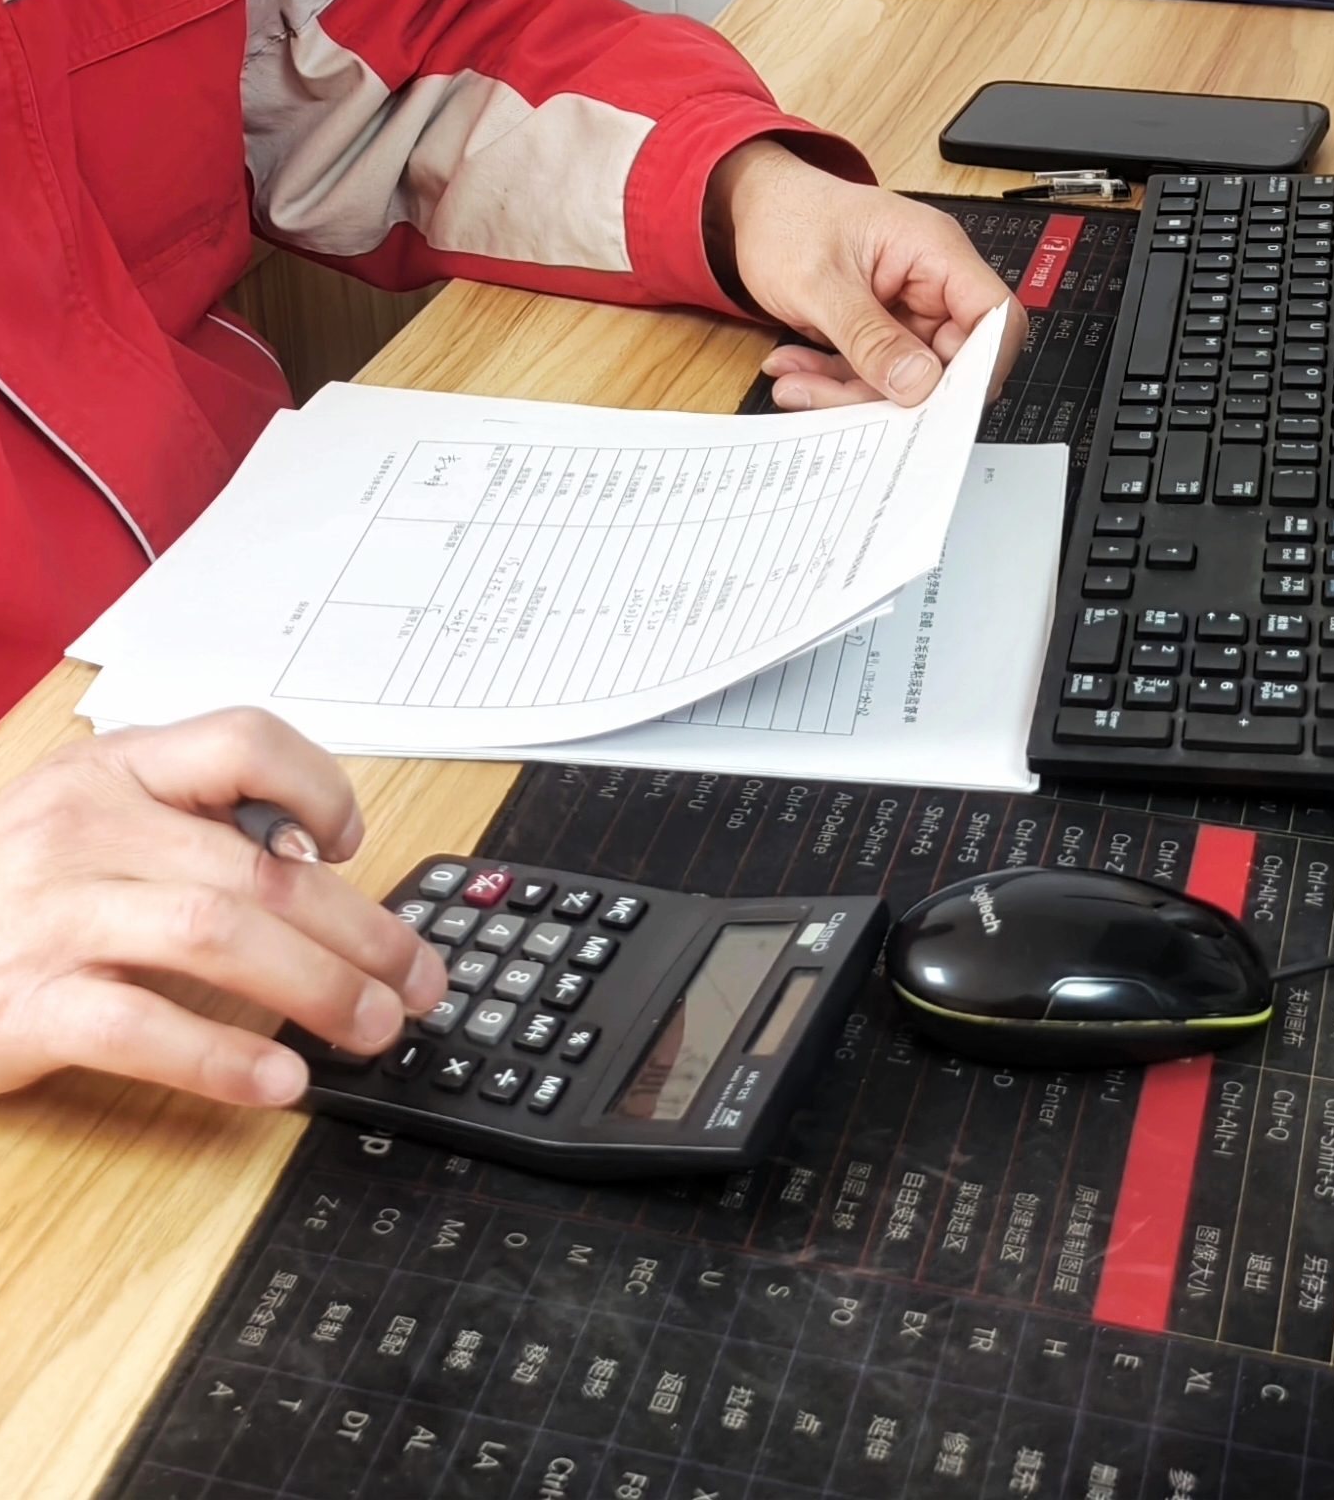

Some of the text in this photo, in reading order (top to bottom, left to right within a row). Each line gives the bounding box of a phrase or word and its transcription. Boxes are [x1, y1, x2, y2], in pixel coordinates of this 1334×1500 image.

[1029, 253, 1057, 288] PPT快捷键
[1054, 319, 1075, 340] Alt+EL
[1083, 321, 1104, 347] Alt+EM
[1228, 613, 1240, 621] 4
[1289, 615, 1303, 623] 7
[1161, 645, 1175, 653] 2
[1224, 647, 1237, 655] 5
[1156, 679, 1170, 687] 3
[1220, 681, 1234, 690] 6
[1284, 684, 1298, 693] 9
[726, 779, 764, 829] Ctrl+Tab
[778, 785, 809, 823] Ctrl+R
[1306, 808, 1324, 816] L
[816, 791, 855, 855] Alt+Delete
[857, 799, 900, 867] Ctrl+Shift+I
[909, 805, 946, 856] Shift+F6
[957, 812, 990, 864] Shift+F5
[1153, 840, 1180, 879] Ctrl+X
[430, 870, 454, 882] 0
[467, 872, 504, 893] C/AC
[1253, 855, 1283, 921] Ctrl+Alt+C
[1304, 861, 1329, 907] Ctrl+W
[443, 918, 466, 926] 1
[605, 896, 638, 920] MC
[969, 883, 1002, 936] logitech
[487, 923, 511, 936] 4
[535, 933, 560, 947] 7
[810, 912, 846, 953] CASIO
[576, 935, 609, 963] MR
[459, 960, 484, 975] 5
[505, 970, 531, 984] 8
[477, 1010, 503, 1025] 9
[524, 1014, 557, 1041] M+
[1282, 987, 1311, 1048] 关闭画布
[568, 1031, 590, 1047] %
[834, 1013, 868, 1060] Ctrl+G
[534, 1075, 566, 1103] MU
[1265, 1089, 1295, 1142] Ctrl+Q
[831, 1160, 873, 1230] 图层上移
[884, 1171, 927, 1242] 自由变换
[303, 1195, 340, 1232] Z+E
[371, 1207, 401, 1235] CO
[941, 1181, 984, 1253] 取消选区
[999, 1192, 1041, 1264] 创建选区
[430, 1219, 466, 1251] MA
[1052, 1184, 1100, 1294] 原位复制图层
[566, 1243, 593, 1265] M
[1186, 1224, 1222, 1298] 图像大小
[622, 1256, 660, 1296] REC
[697, 1270, 725, 1287] U
[1242, 1251, 1276, 1292] 退出
[1298, 1253, 1329, 1314] 另存为
[766, 1283, 791, 1298] S
[236, 1270, 299, 1347] 显示全图
[309, 1300, 353, 1343] 复制
[829, 1296, 858, 1327] PO
[376, 1314, 419, 1357] 匹配
[898, 1310, 928, 1340] EX
[967, 1327, 999, 1351] TR
[441, 1329, 484, 1373] 偏移
[1042, 1338, 1068, 1358] H
[1112, 1352, 1144, 1371] E
[510, 1342, 550, 1385] 移动
[580, 1355, 620, 1400] 矩形
[207, 1380, 236, 1398] A
[647, 1370, 688, 1415] 返回
[1183, 1367, 1213, 1395] XL
[1260, 1382, 1290, 1403] C
[276, 1399, 304, 1413] T
[720, 1384, 757, 1431] 拉伸
[334, 1410, 372, 1444] DT
[402, 1425, 438, 1452] AL
[792, 1409, 824, 1438] 点
[864, 1415, 899, 1462] 延伸
[471, 1441, 508, 1470] LA
[933, 1431, 972, 1479] 修剪
[614, 1471, 650, 1500] F8
[1007, 1446, 1046, 1495] 填充
